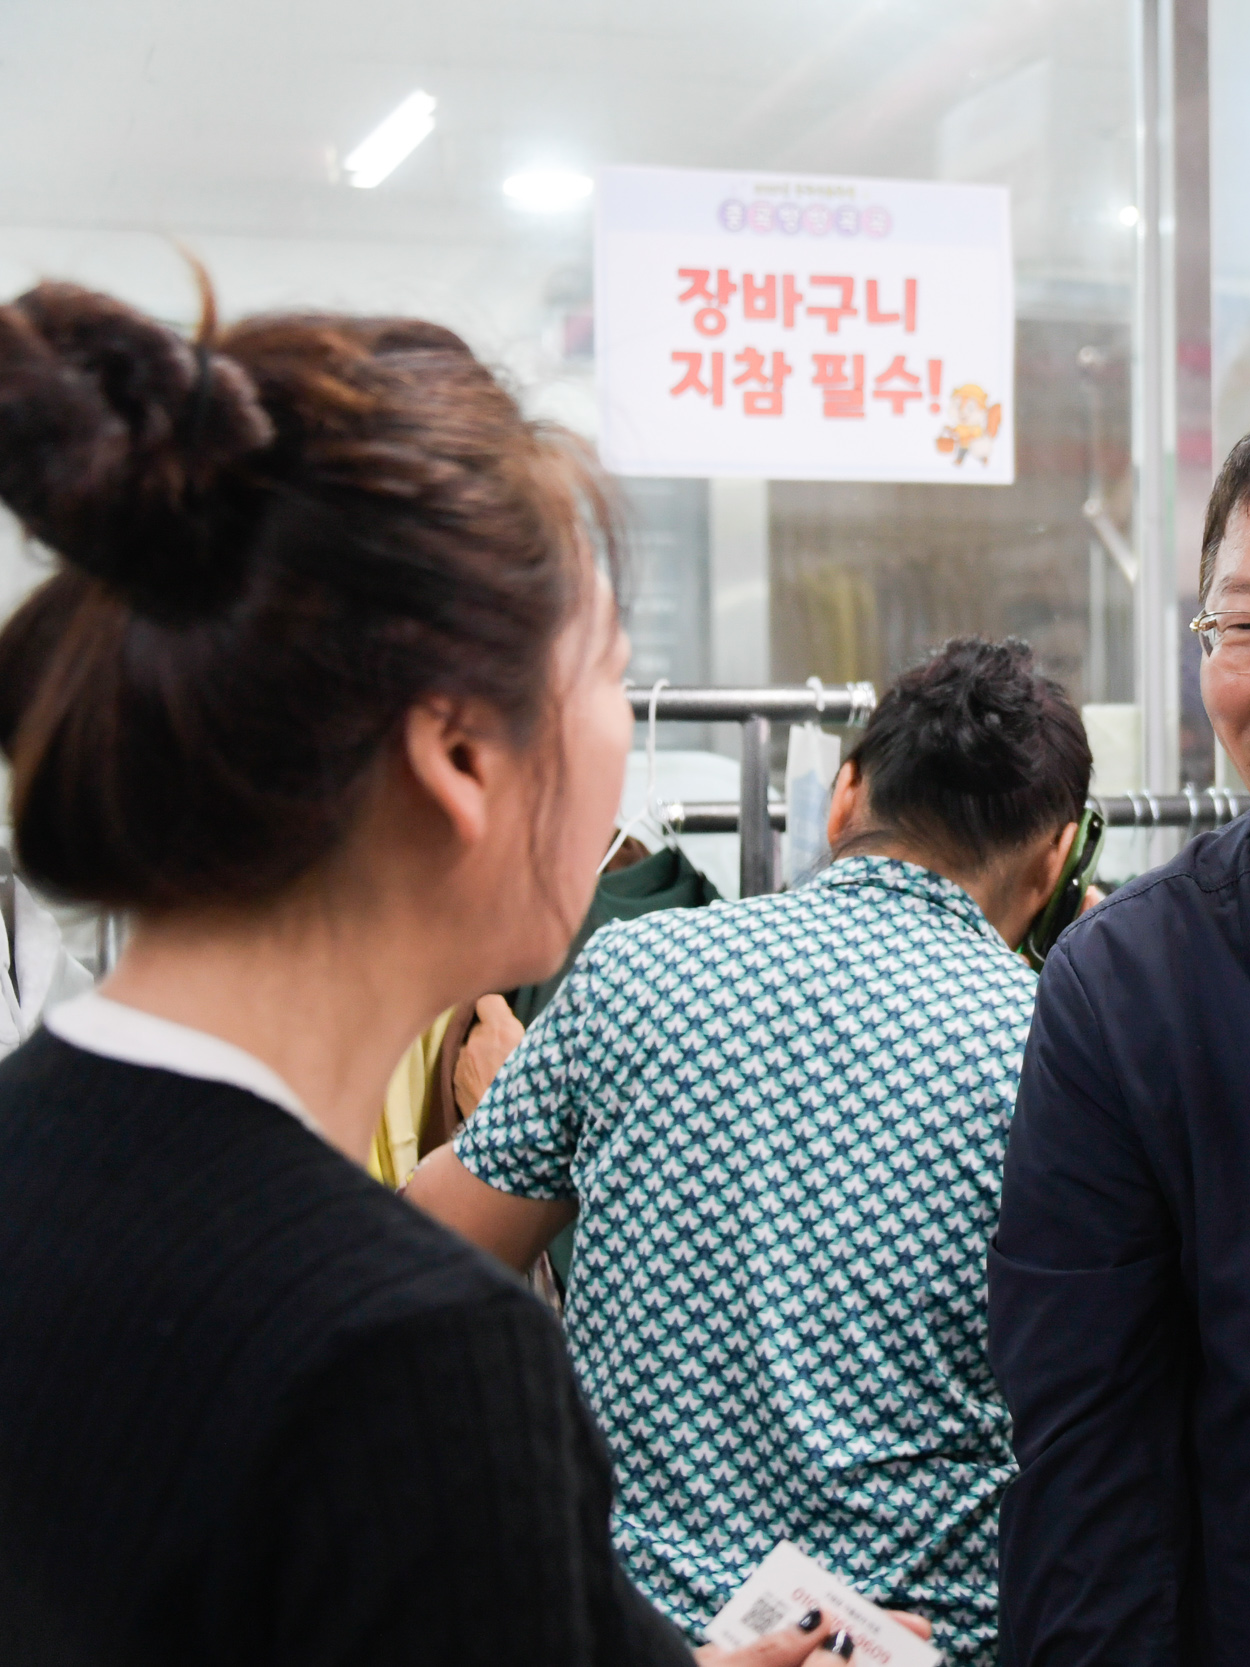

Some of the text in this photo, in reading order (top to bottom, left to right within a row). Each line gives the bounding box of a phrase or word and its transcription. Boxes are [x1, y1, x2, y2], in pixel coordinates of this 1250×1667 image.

[677, 267, 918, 337] 장바구니
[669, 346, 943, 418] 지참 필수!
